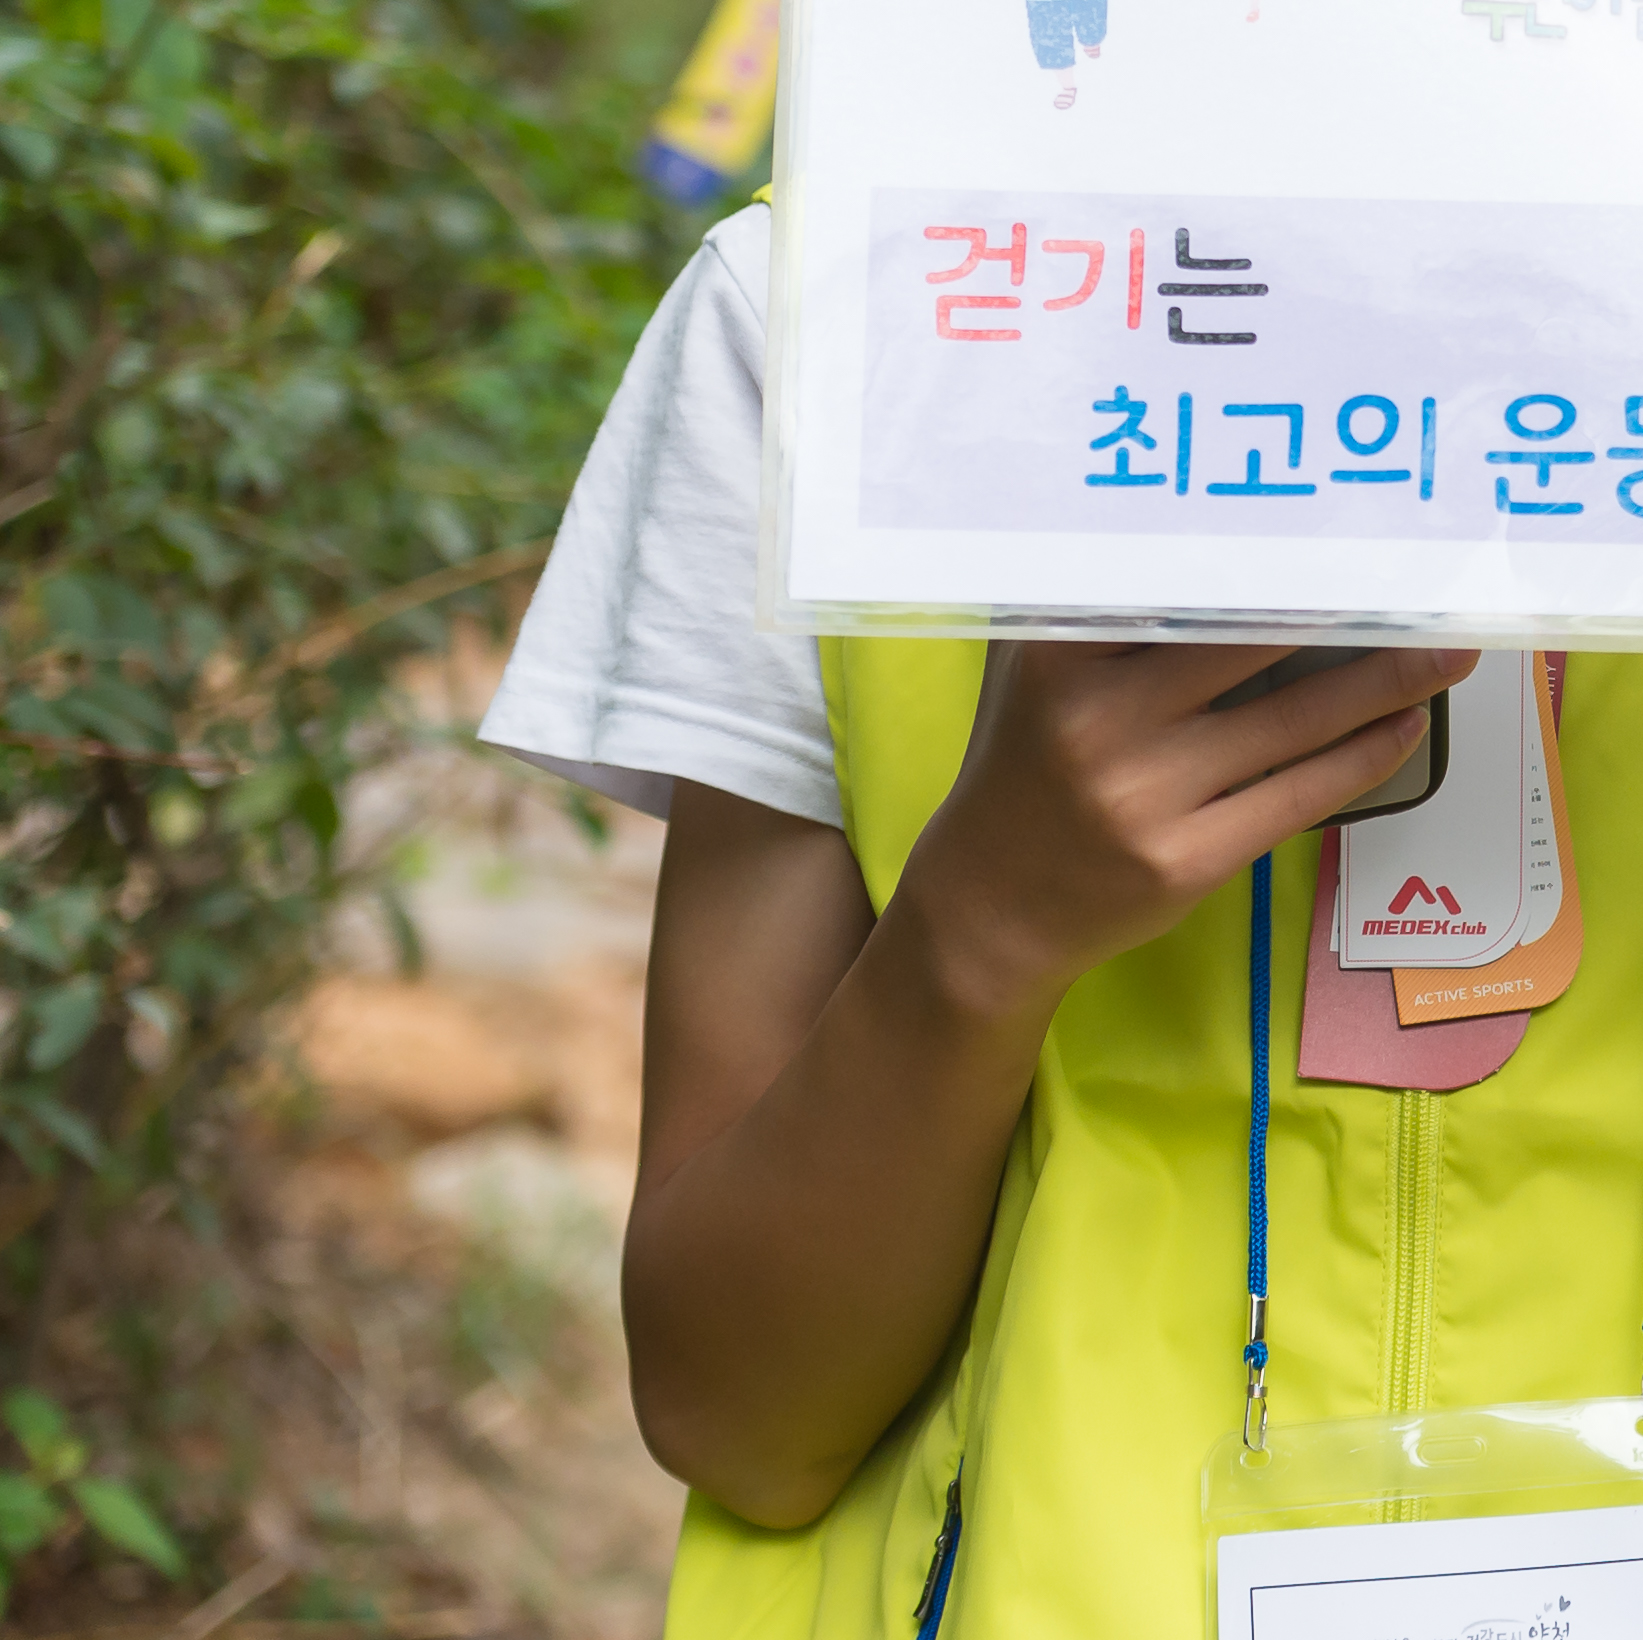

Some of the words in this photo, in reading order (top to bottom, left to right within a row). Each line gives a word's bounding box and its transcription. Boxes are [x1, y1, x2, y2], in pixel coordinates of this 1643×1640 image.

[923, 222, 1269, 345] 걷기는
[1084, 385, 1437, 501] 최고의
[1414, 987, 1467, 1006] ACTIVE
[1472, 978, 1534, 998] SPORTS
